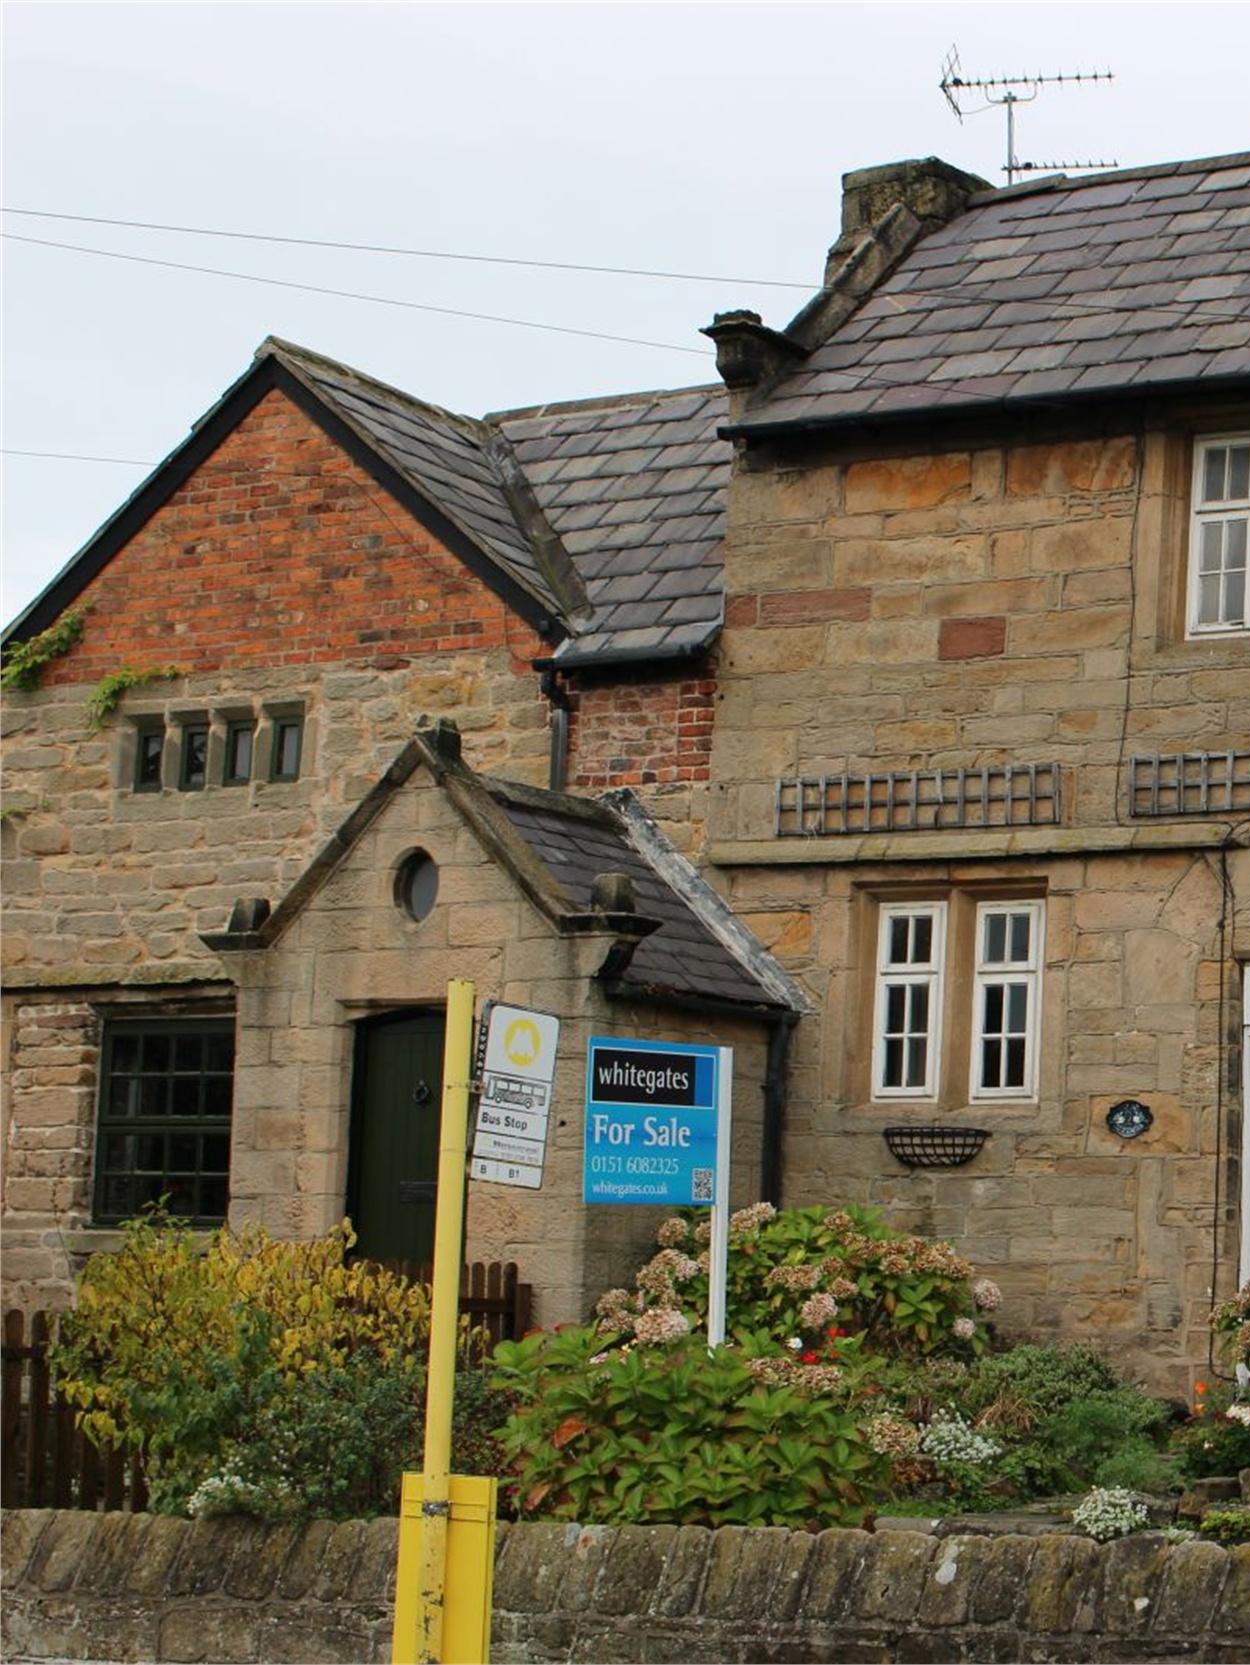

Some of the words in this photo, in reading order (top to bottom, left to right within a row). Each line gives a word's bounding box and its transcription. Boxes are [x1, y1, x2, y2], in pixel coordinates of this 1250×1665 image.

[598, 1061, 690, 1095] whitegates
[481, 1111, 502, 1126] Bus
[504, 1115, 528, 1131] Stop
[593, 1114, 636, 1146] For
[643, 1116, 692, 1148] Sale
[591, 1155, 622, 1174] 0151
[626, 1156, 680, 1175] 6082325
[592, 1179, 669, 1199] whitegates.co.uk
